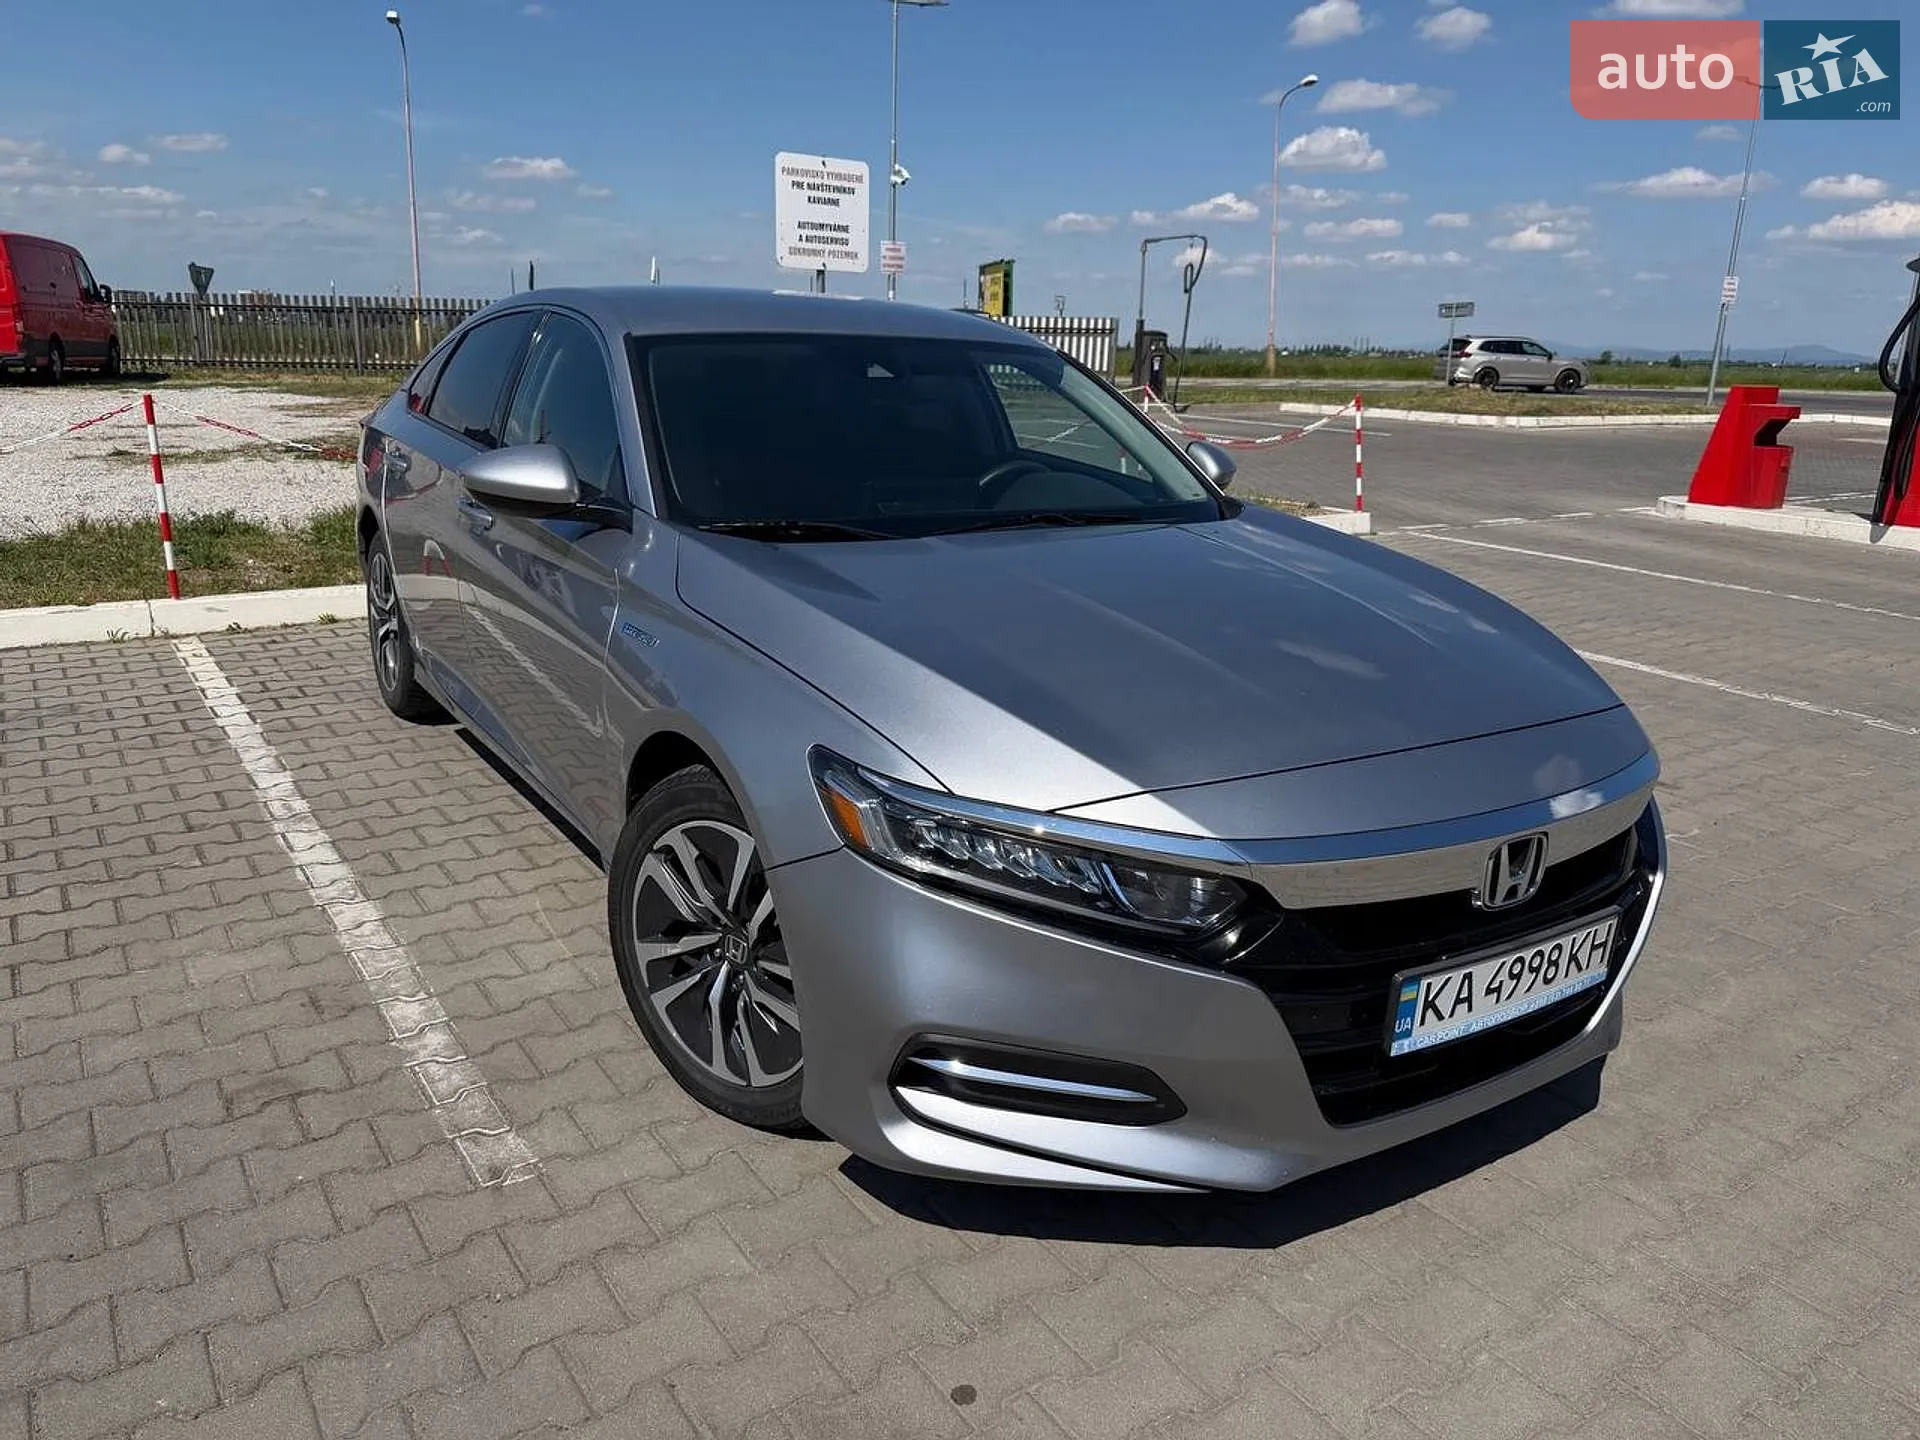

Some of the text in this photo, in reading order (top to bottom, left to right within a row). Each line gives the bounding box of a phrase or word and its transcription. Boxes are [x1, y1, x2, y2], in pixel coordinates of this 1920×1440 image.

[791, 180, 805, 190] PRE
[798, 234, 804, 243] A
[1418, 970, 1474, 1027] KA
[1483, 943, 1562, 1005] 4998
[1564, 922, 1613, 978] KH
[1394, 1017, 1412, 1034] UA
